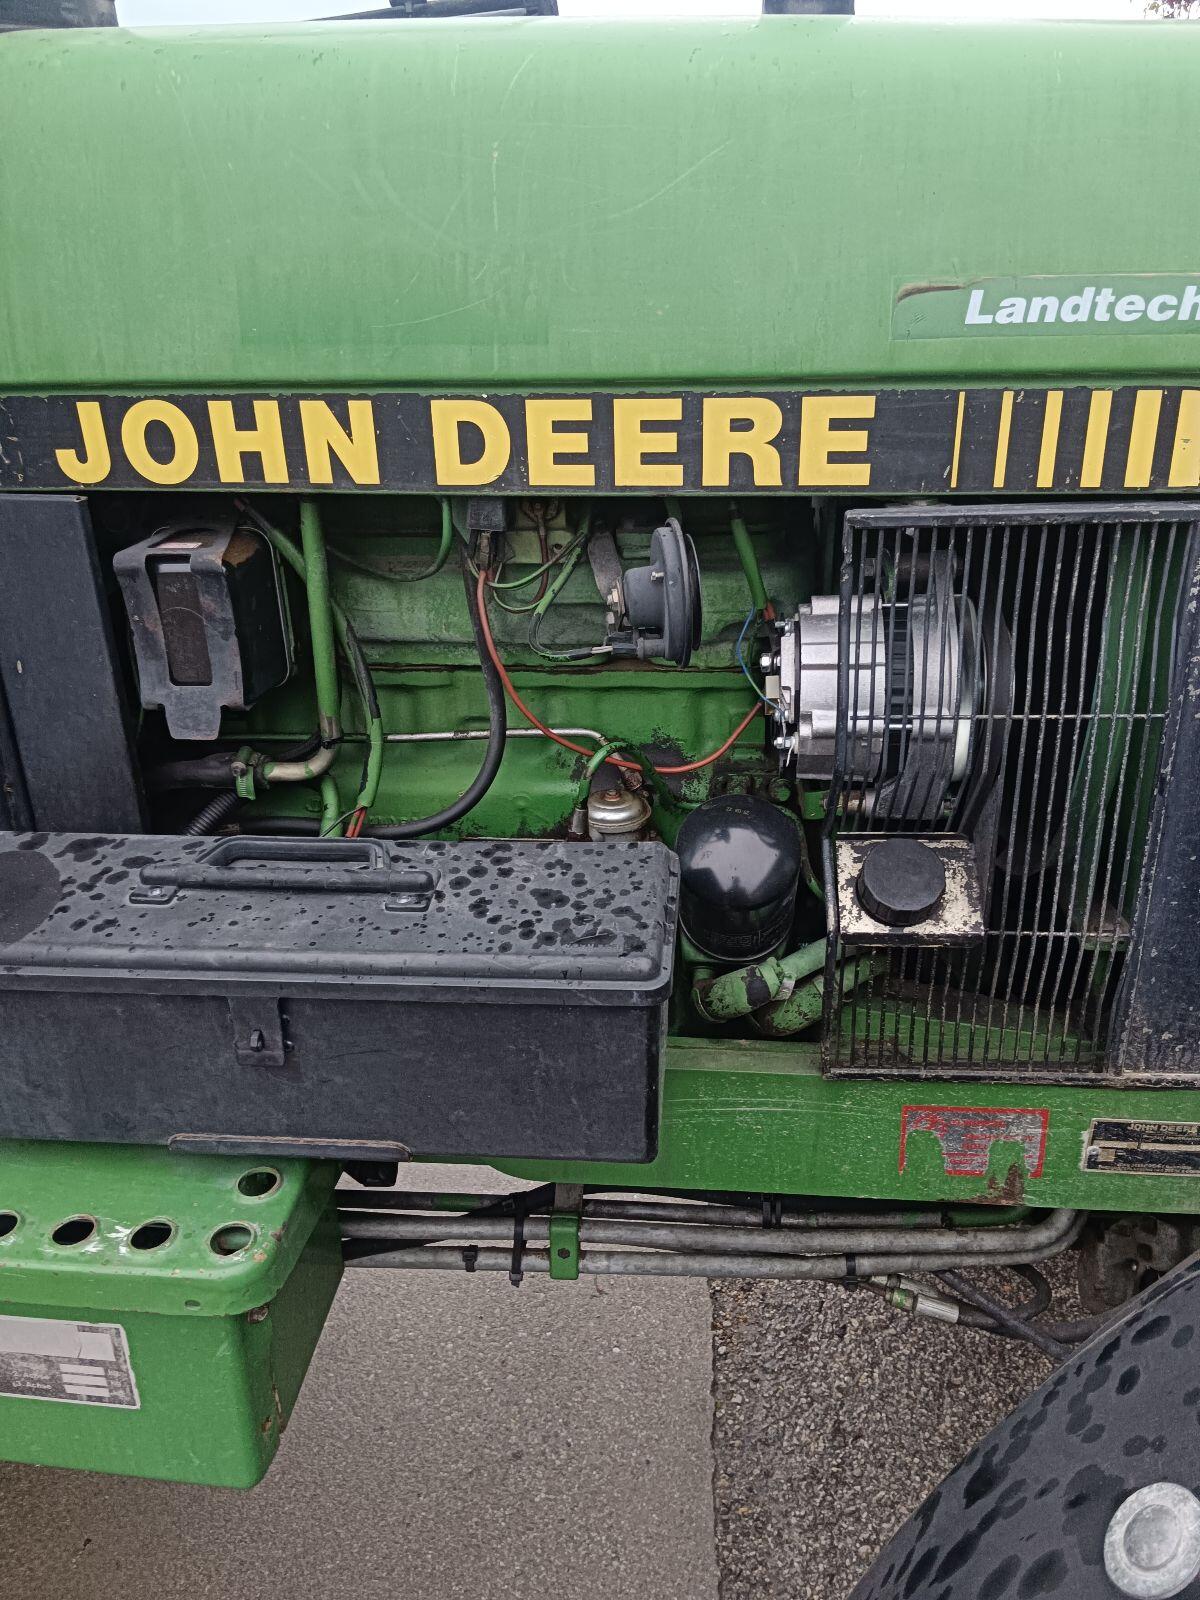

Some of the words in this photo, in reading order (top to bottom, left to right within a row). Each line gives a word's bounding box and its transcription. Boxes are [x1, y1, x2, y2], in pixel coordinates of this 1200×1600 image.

[965, 286, 1200, 324] Landtech
[55, 399, 381, 485] JOHN
[430, 395, 876, 487] DEERE
[1127, 1123, 1158, 1132] JOHN
